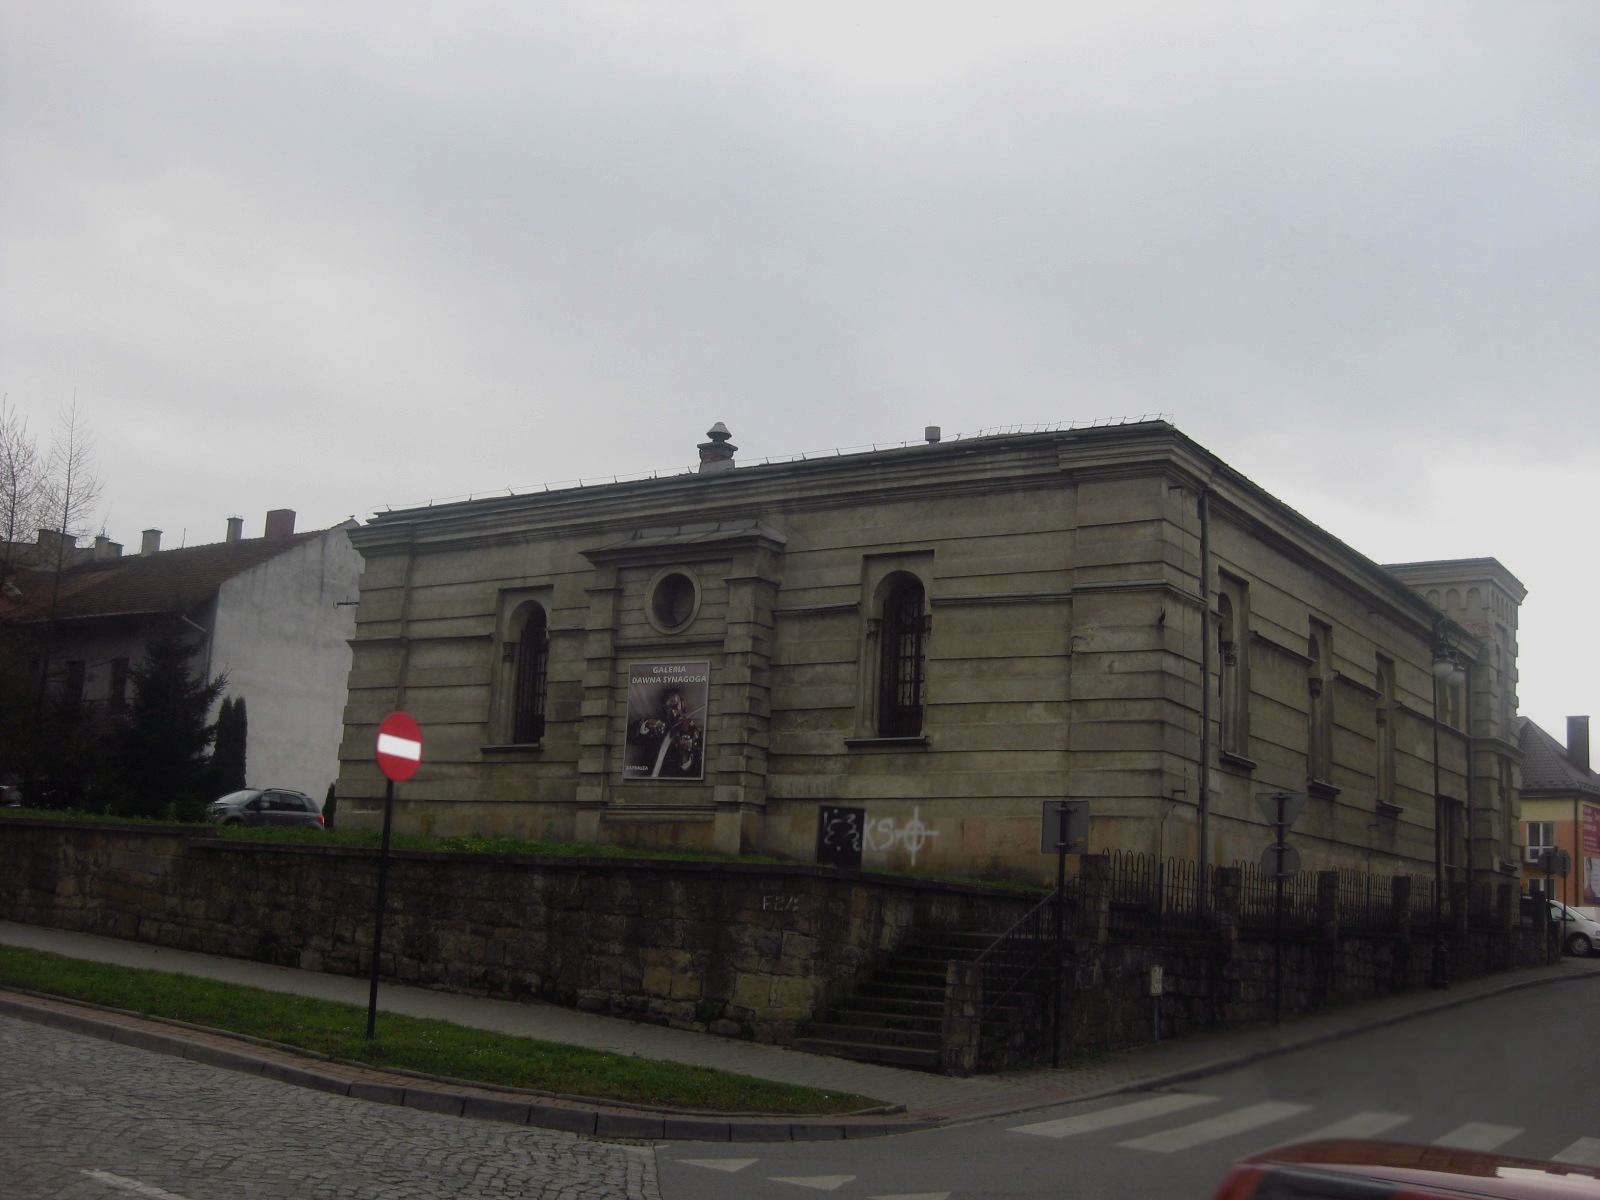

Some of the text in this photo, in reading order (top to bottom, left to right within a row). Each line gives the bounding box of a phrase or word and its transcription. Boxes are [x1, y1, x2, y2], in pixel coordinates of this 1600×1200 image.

[652, 665, 687, 674] GALERIA
[631, 675, 707, 684] DAWNA SYNAGOGA
